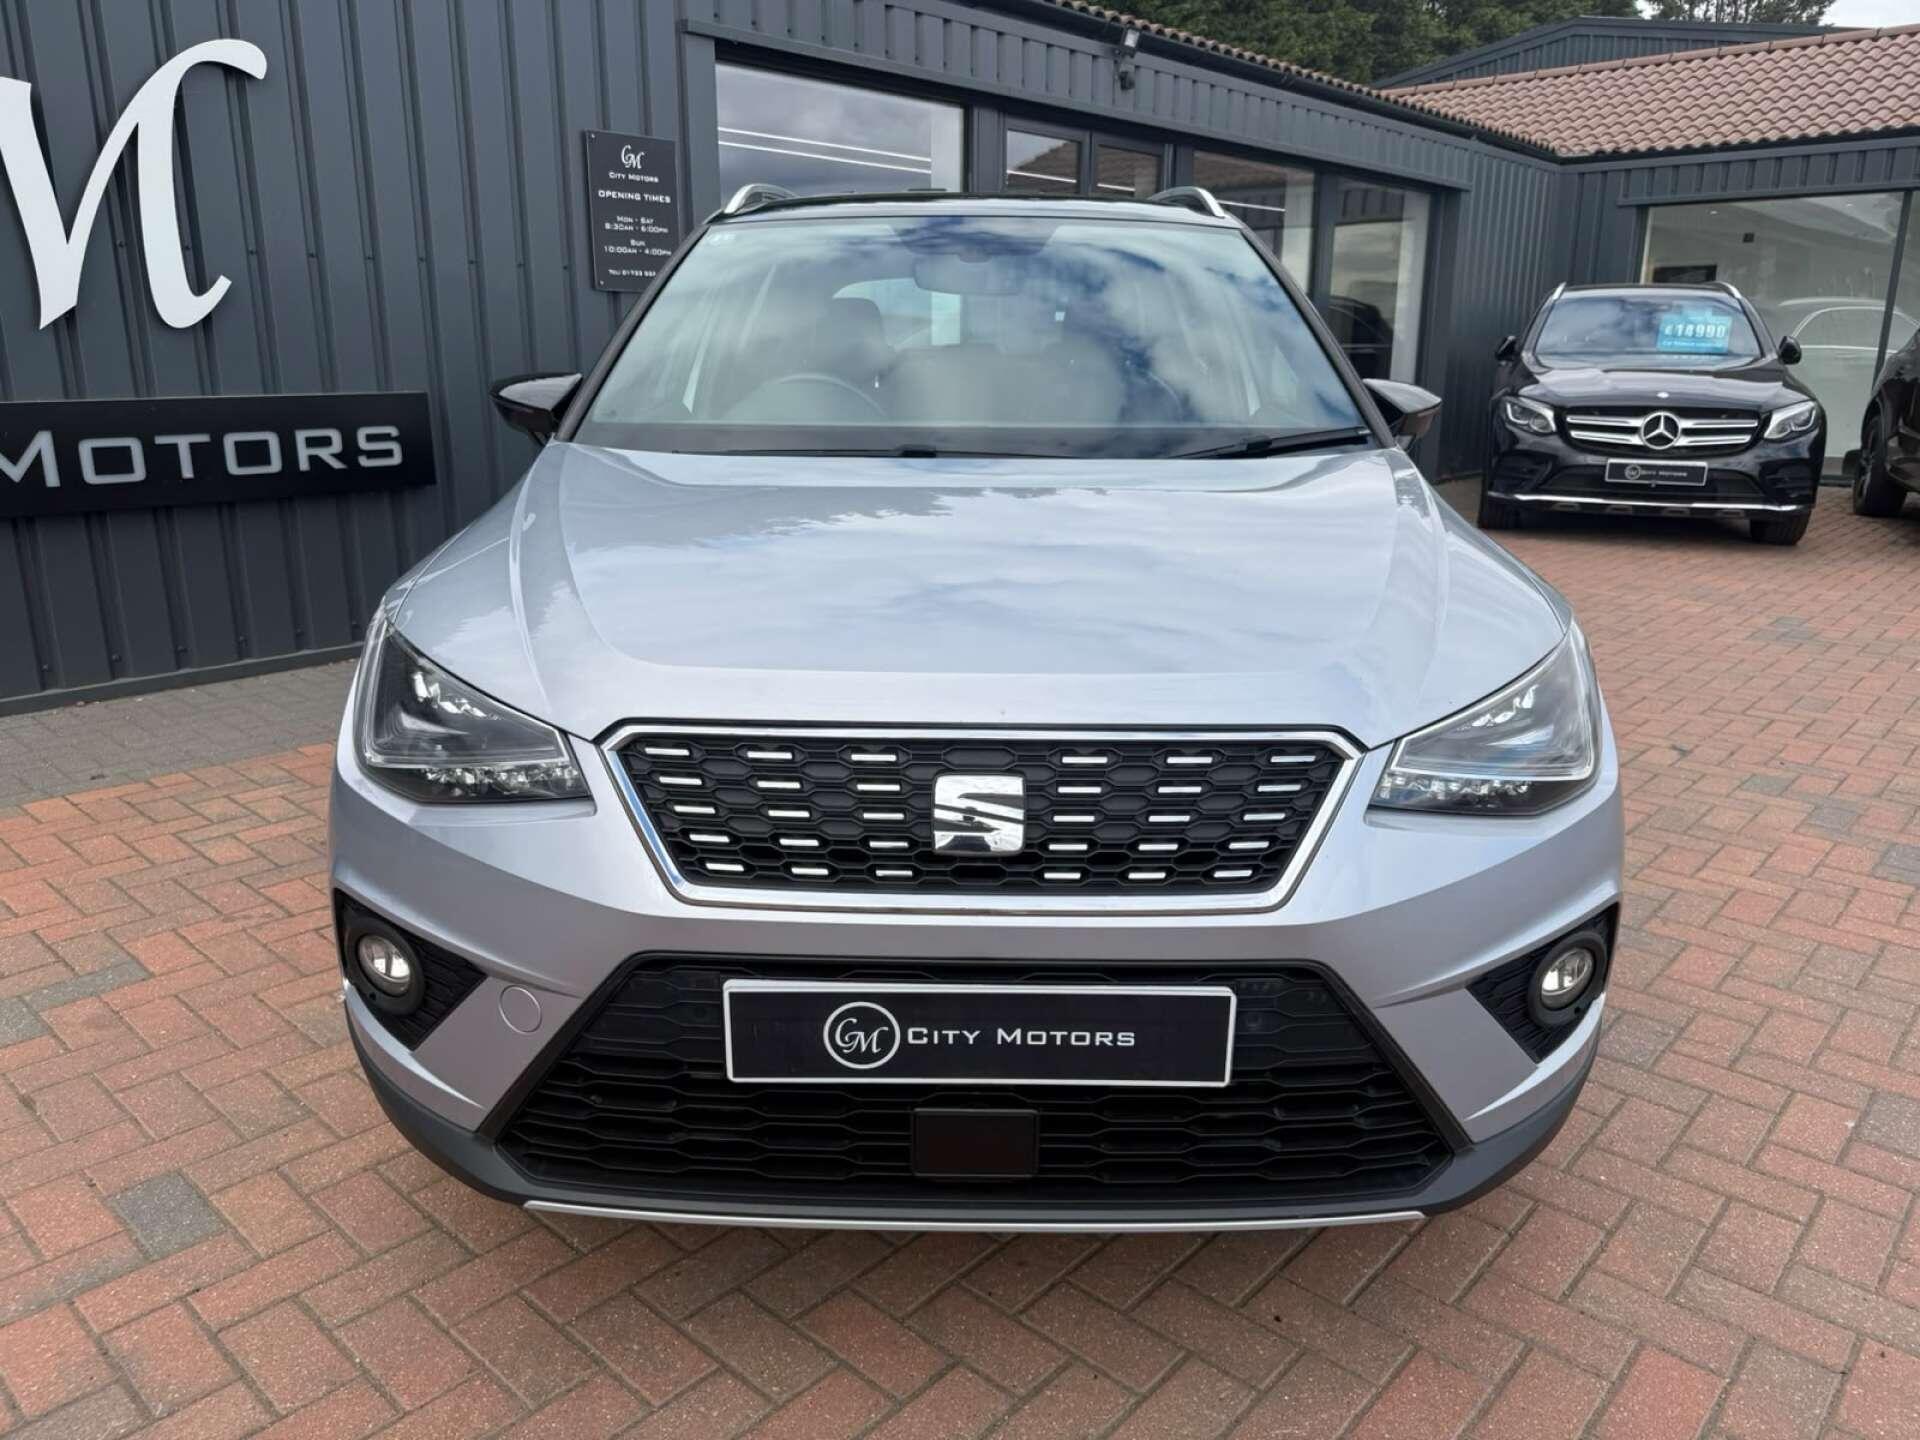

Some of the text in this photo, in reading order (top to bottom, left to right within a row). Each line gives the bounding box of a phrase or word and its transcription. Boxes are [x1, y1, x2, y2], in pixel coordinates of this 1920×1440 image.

[628, 174, 659, 183] MOTORS
[598, 190, 671, 203] OPENING TIMES
[616, 215, 634, 223] MON
[0, 426, 402, 487] MOTORS
[907, 1027, 981, 1045] CITY
[997, 1028, 1135, 1046] MOTORS
